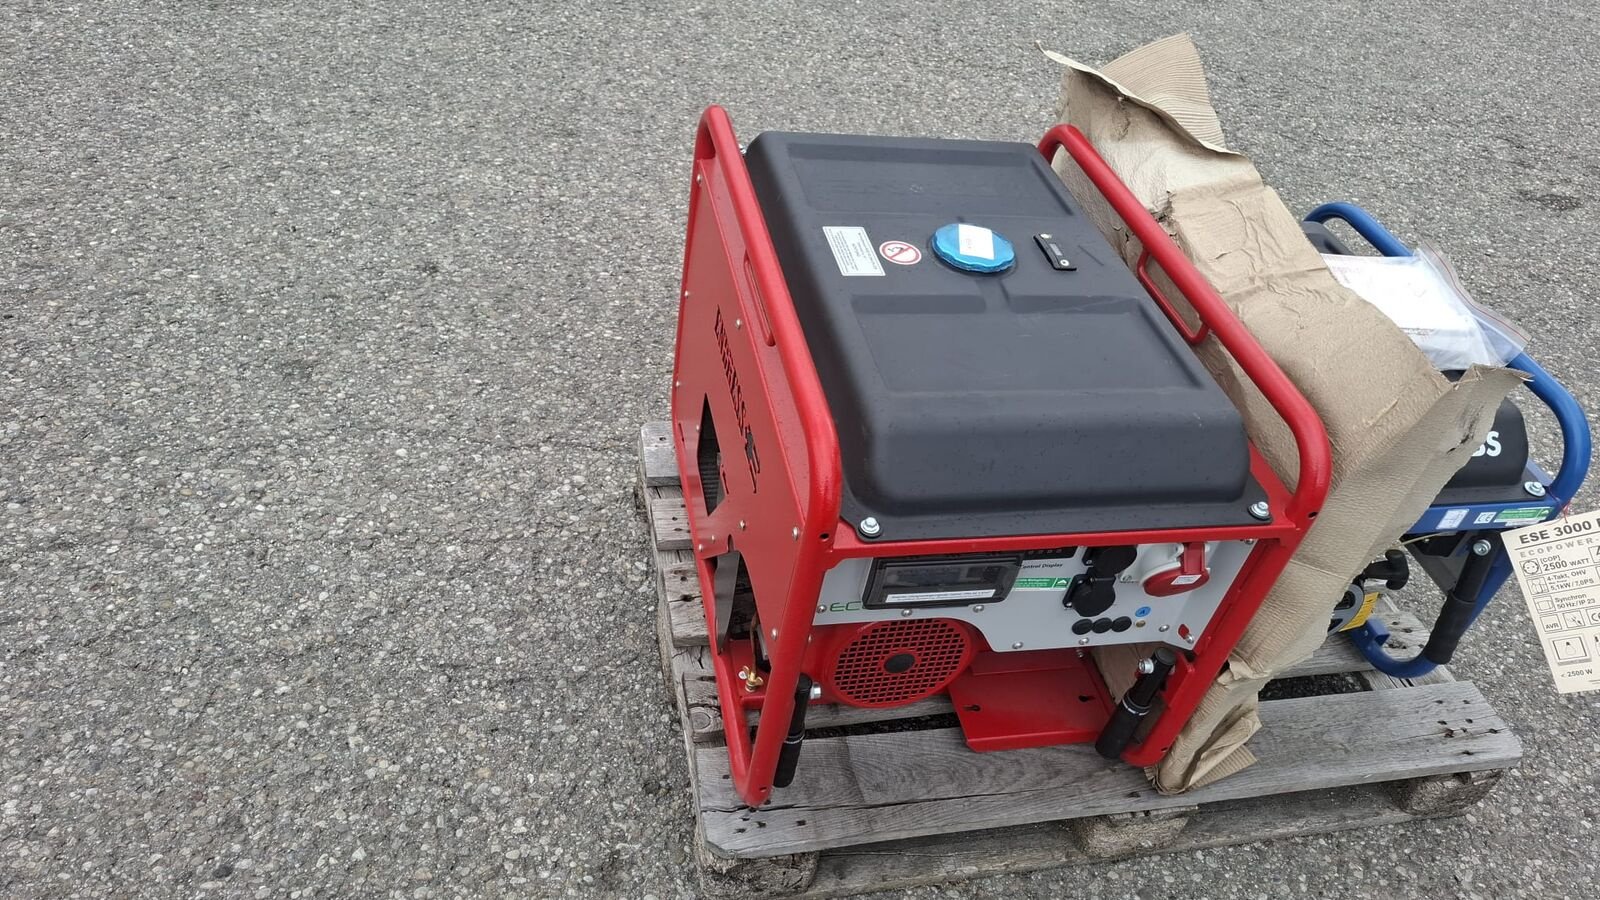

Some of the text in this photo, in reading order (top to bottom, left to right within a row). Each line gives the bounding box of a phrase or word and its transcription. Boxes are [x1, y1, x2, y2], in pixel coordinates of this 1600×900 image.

[1519, 530, 1550, 544] ESE
[1553, 521, 1592, 537] 3000
[1543, 558, 1590, 571] 2500 WATT
[1571, 569, 1586, 577] OHV
[1555, 594, 1587, 603] Synchron
[1545, 622, 1560, 630] AVR
